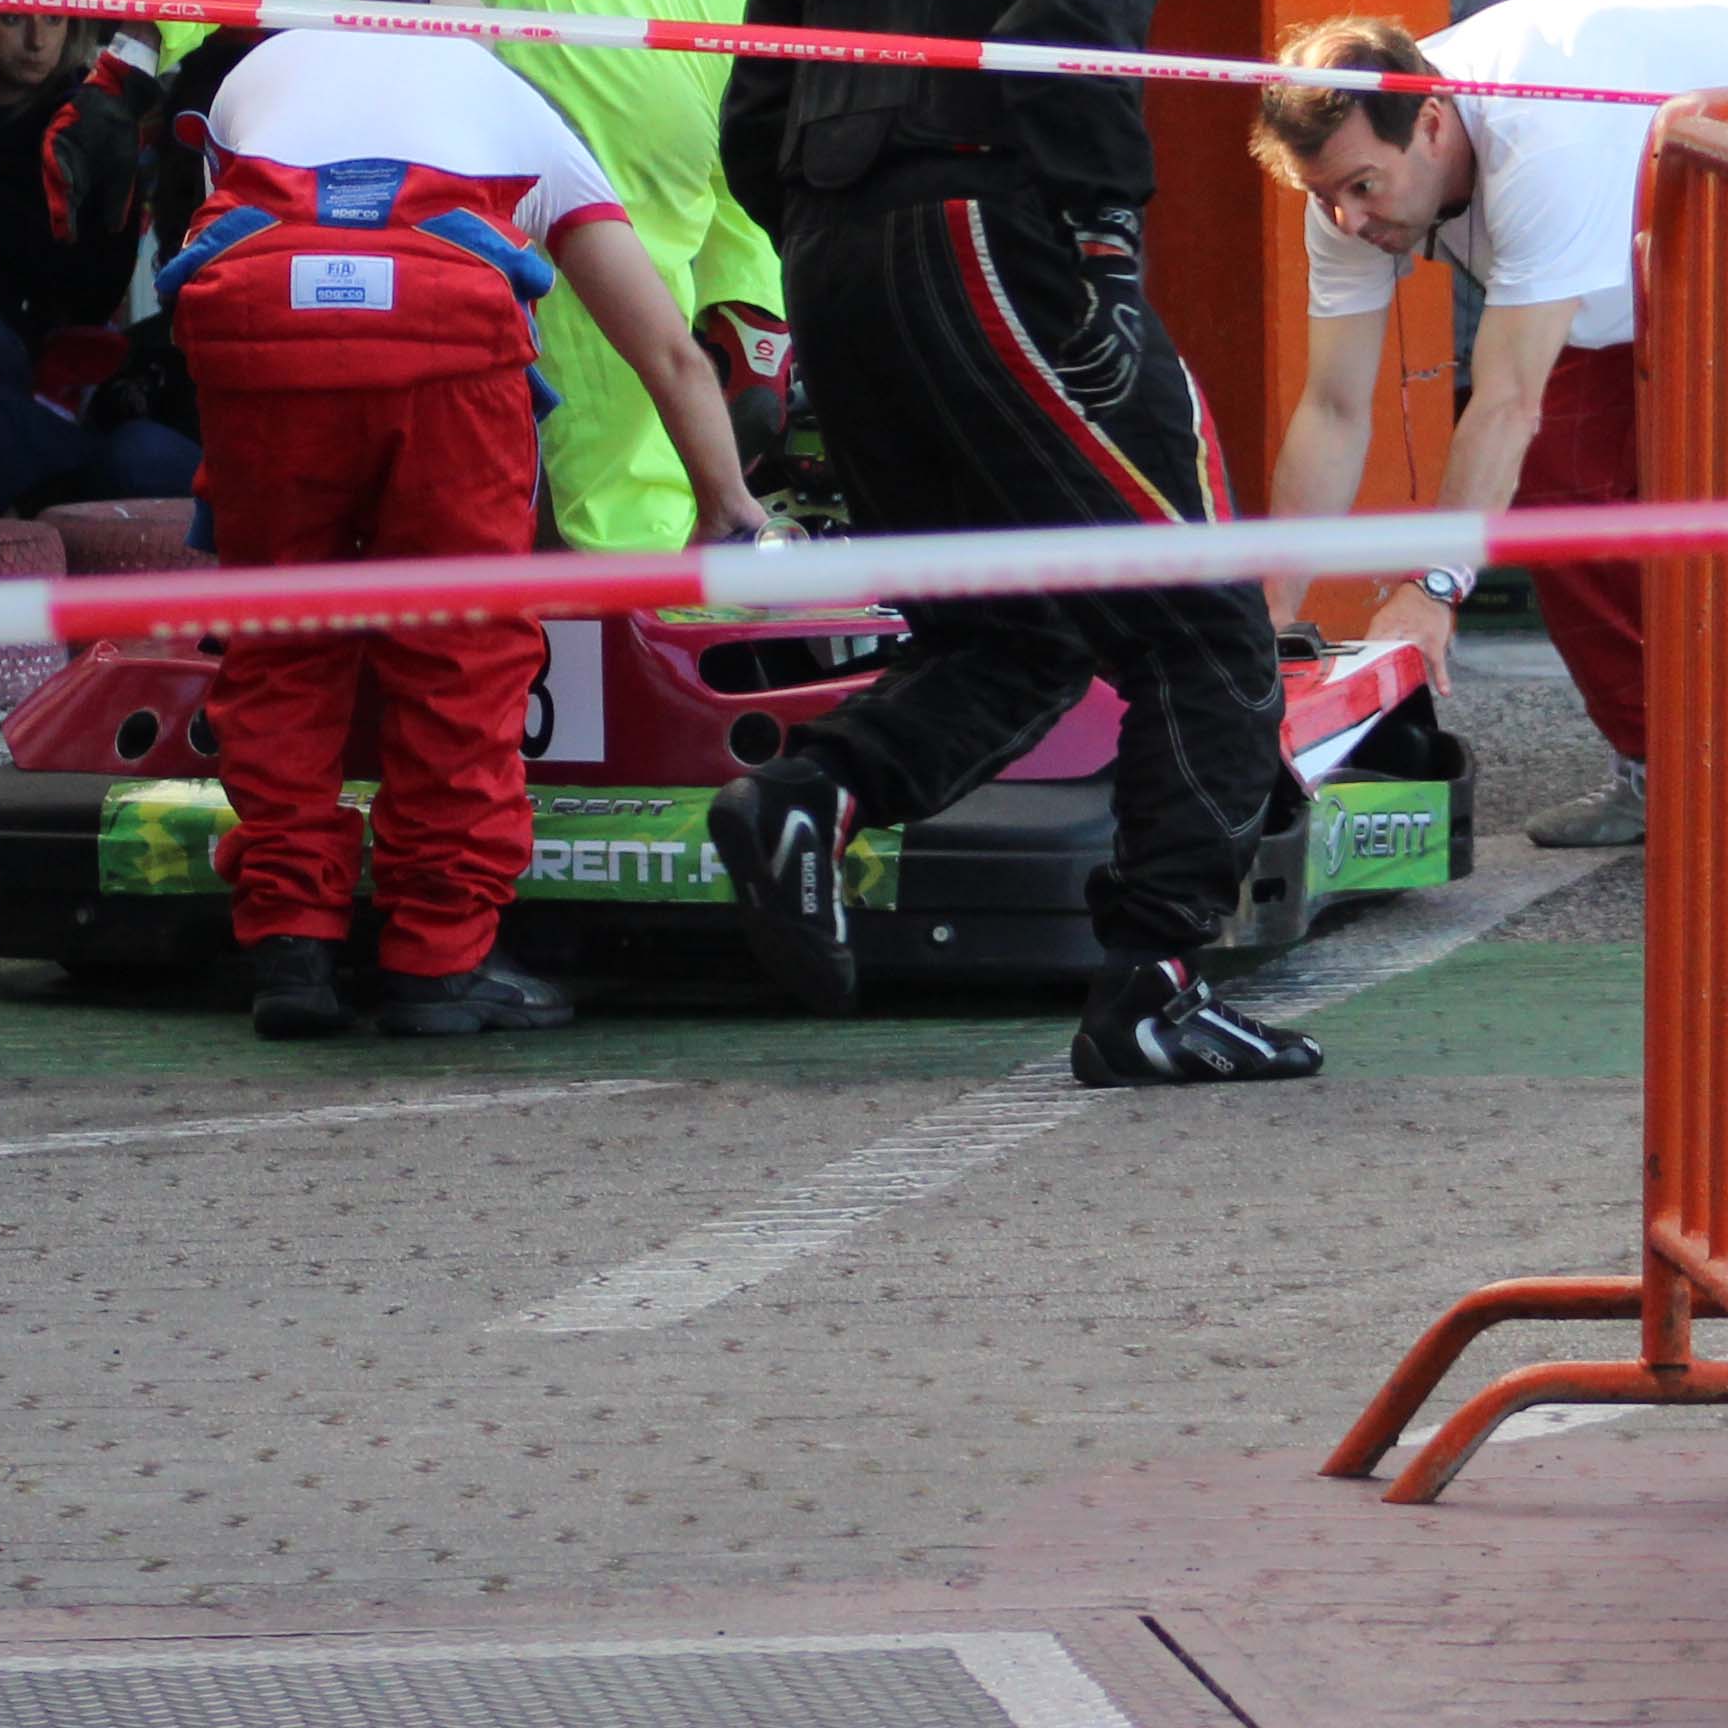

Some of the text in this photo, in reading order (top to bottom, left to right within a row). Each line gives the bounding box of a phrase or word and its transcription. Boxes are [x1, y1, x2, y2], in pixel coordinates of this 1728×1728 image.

[331, 207, 380, 221] sparco
[317, 287, 364, 301] sparco
[547, 798, 676, 817] RENT
[1352, 811, 1432, 859] RENT
